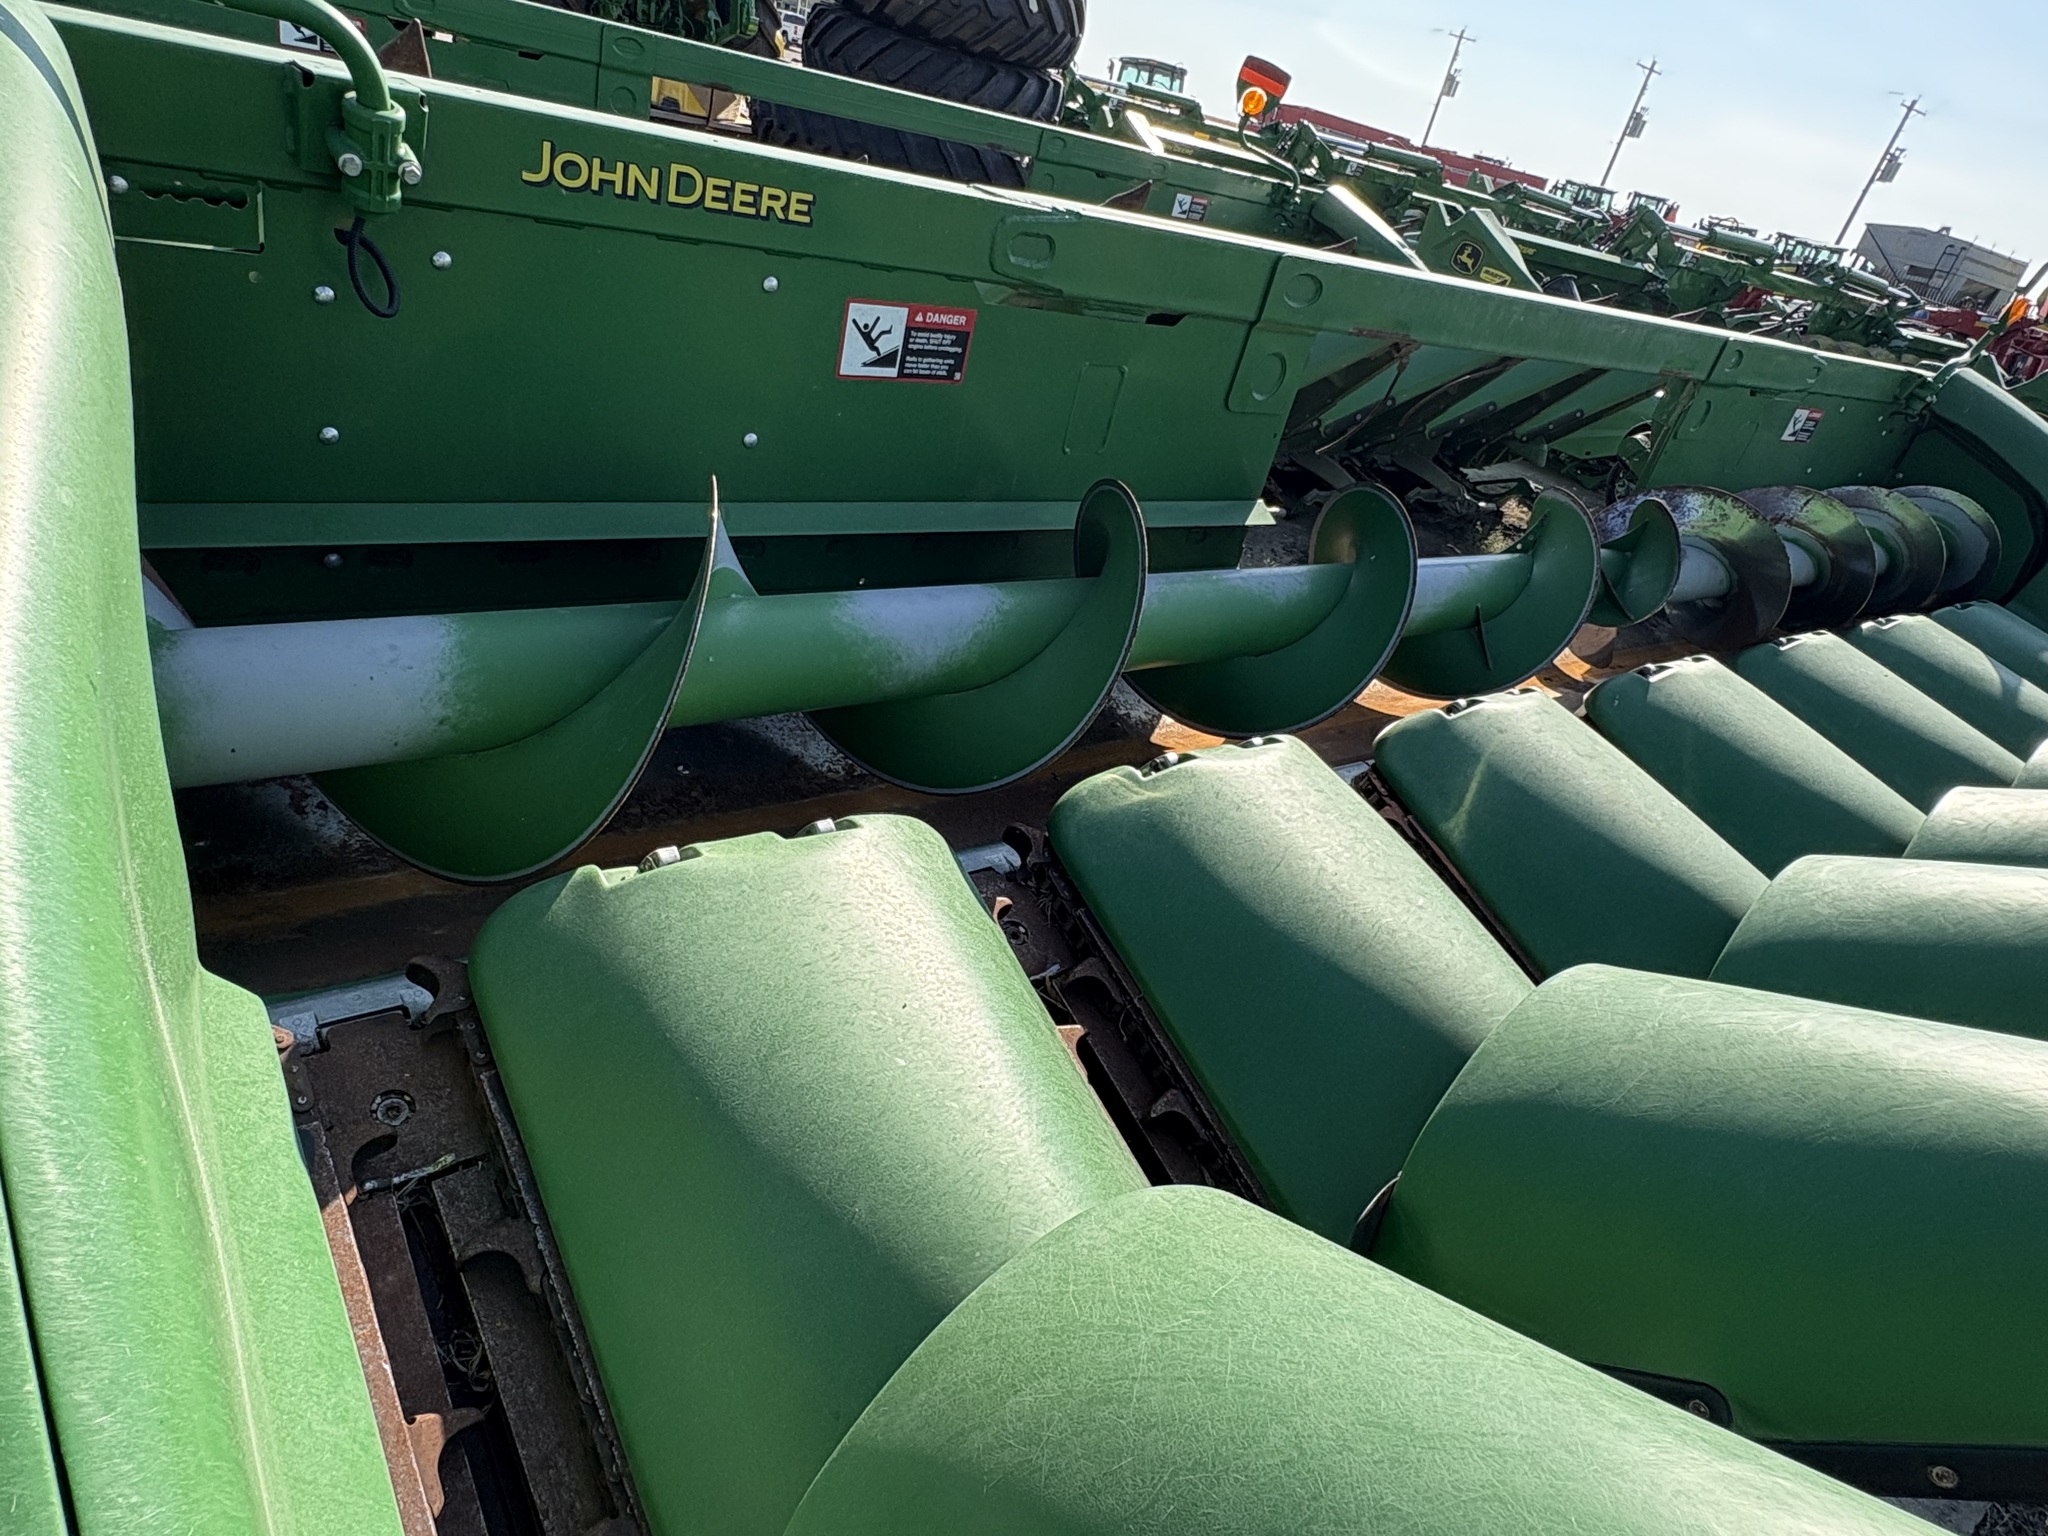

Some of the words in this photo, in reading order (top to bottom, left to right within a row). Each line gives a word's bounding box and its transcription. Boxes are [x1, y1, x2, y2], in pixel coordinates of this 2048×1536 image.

[521, 140, 661, 202] JOHN
[666, 162, 816, 226] DEERE
[925, 312, 967, 326] DANGER
